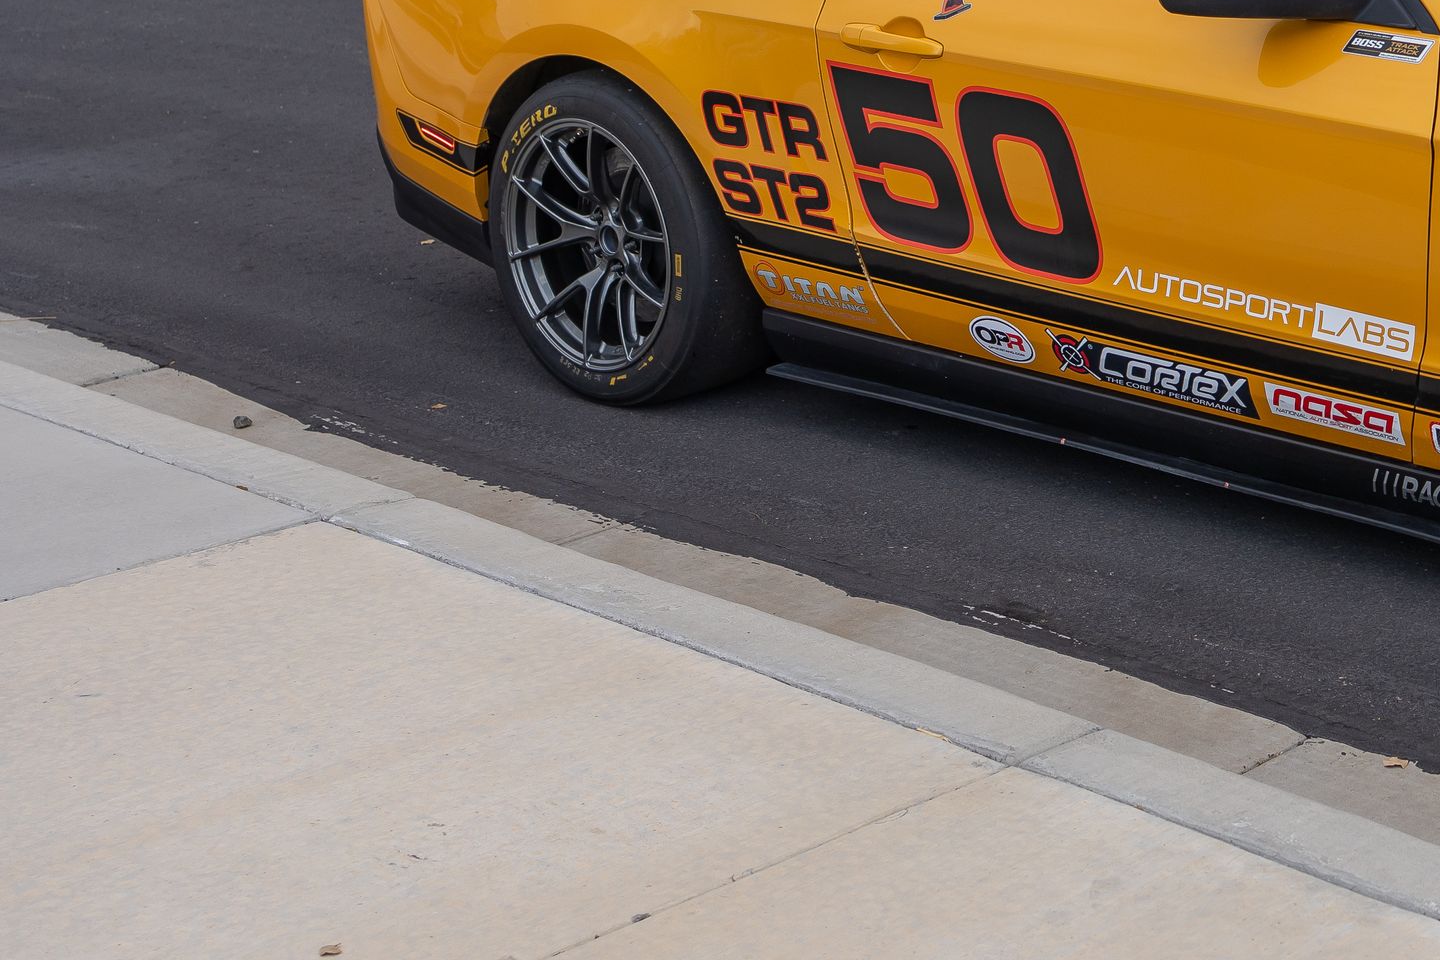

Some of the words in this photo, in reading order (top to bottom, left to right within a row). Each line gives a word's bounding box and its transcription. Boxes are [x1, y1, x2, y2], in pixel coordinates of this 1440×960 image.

[1351, 37, 1385, 49] BOSS
[1385, 47, 1419, 56] ATTACK
[1391, 41, 1421, 50] TRACK
[702, 89, 830, 162] GTR
[826, 59, 1103, 285] 50
[712, 157, 838, 234] ST2
[757, 269, 865, 305] TITAN
[1113, 266, 1314, 328] AUTOSPORT
[1317, 310, 1410, 353] LABS
[974, 325, 1026, 353] OPR
[1105, 376, 1124, 386] THE
[1126, 381, 1152, 393] CORE
[1153, 387, 1166, 395] OF
[1168, 391, 1242, 415] PERFORMANCE
[1273, 388, 1395, 435] nasa
[1275, 407, 1309, 420] NATIONAL
[1309, 415, 1329, 425] AUTO
[1329, 419, 1353, 430] SPORT
[1353, 426, 1400, 442] ASSOCIATION
